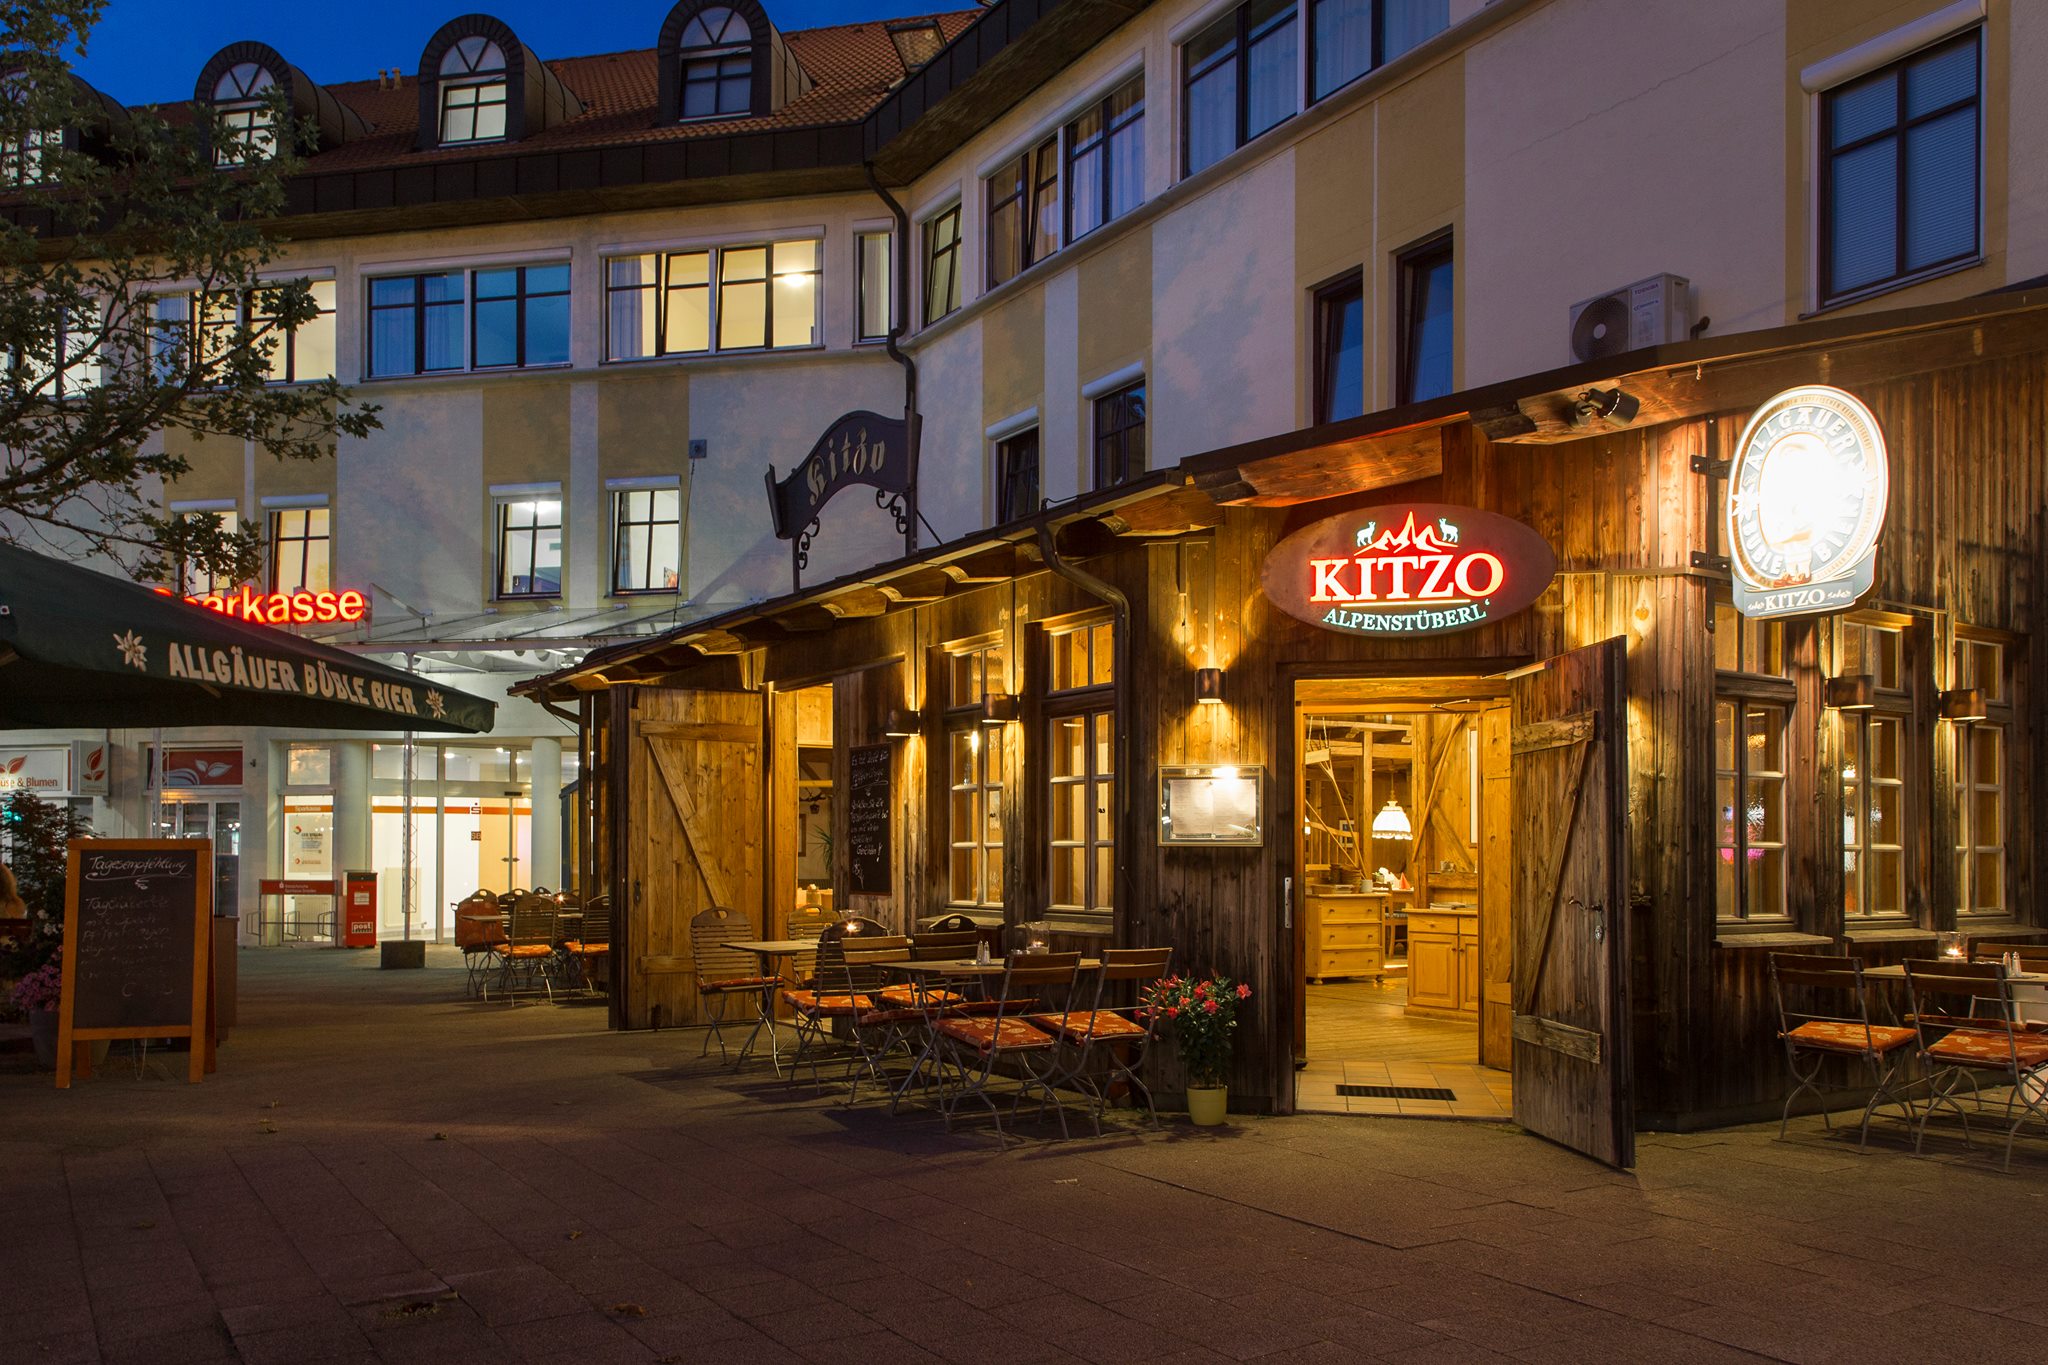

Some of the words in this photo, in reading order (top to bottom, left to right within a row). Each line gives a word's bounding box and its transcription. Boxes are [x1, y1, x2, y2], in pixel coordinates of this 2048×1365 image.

[1309, 552, 1505, 603] KITZO
[153, 585, 366, 624] arkasse
[1764, 588, 1826, 612] KITZO
[169, 642, 301, 693] ALLGÄUER
[303, 660, 369, 706] BÜBLE
[371, 680, 419, 715] BIER
[26, 776, 58, 787] Blumen
[89, 856, 188, 876] Tagesempfehlung
